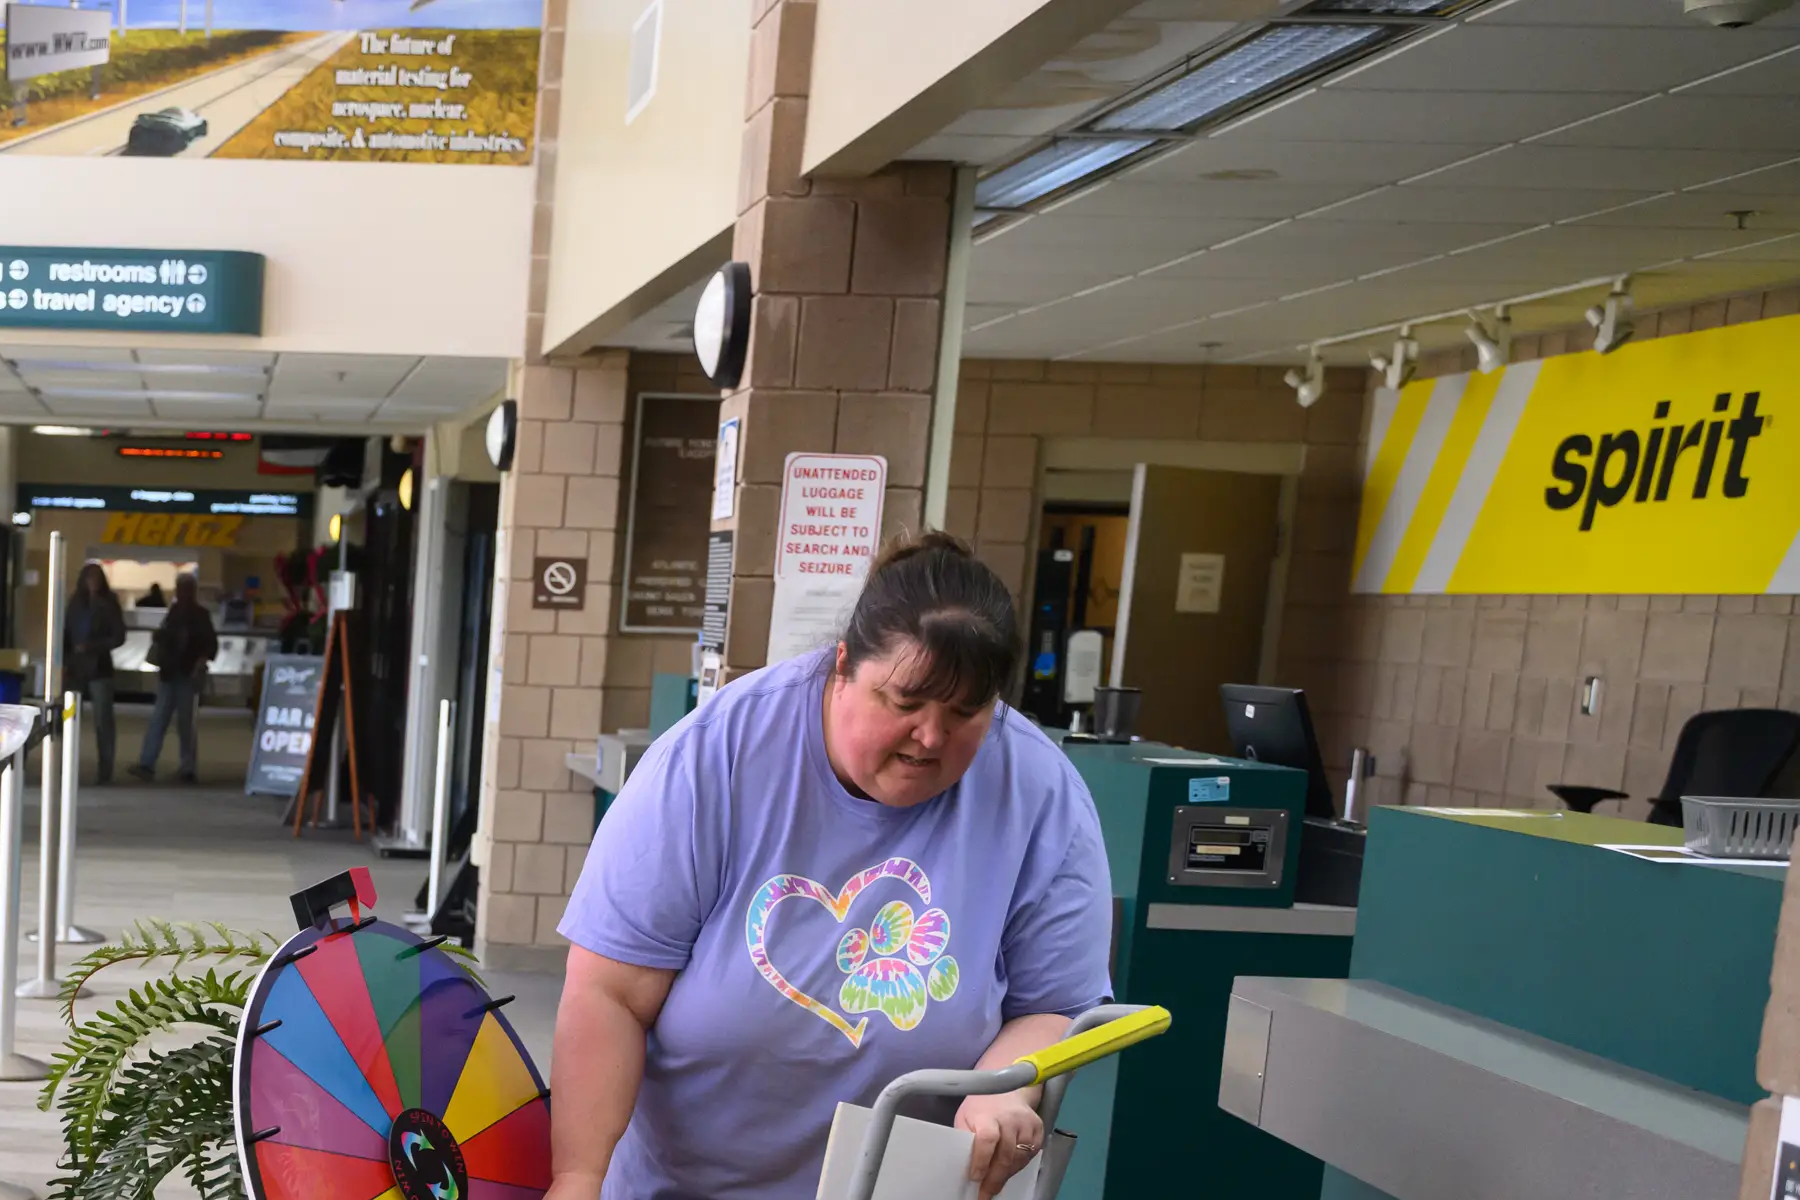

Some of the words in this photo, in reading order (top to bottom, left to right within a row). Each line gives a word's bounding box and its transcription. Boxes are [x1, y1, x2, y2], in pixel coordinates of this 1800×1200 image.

[360, 32, 387, 54] The
[389, 34, 435, 55] future
[436, 34, 455, 55] of
[335, 64, 397, 85] material
[399, 65, 447, 90] testing
[449, 67, 473, 88] for
[351, 128, 366, 148] &
[49, 261, 157, 284] restrooms
[33, 288, 96, 311] travel
[101, 293, 186, 318] agency
[1545, 391, 1765, 531] spirit
[794, 467, 877, 482] UNATTENDED
[802, 487, 864, 500] LUGGAGE
[807, 506, 836, 518] WILL
[840, 508, 857, 518] BE
[791, 524, 847, 538] SUBJECT
[852, 527, 869, 538] TO
[786, 543, 839, 555] SEARCH
[843, 545, 871, 557] AND
[799, 562, 853, 575] SEIZURE
[266, 706, 302, 726] BAR
